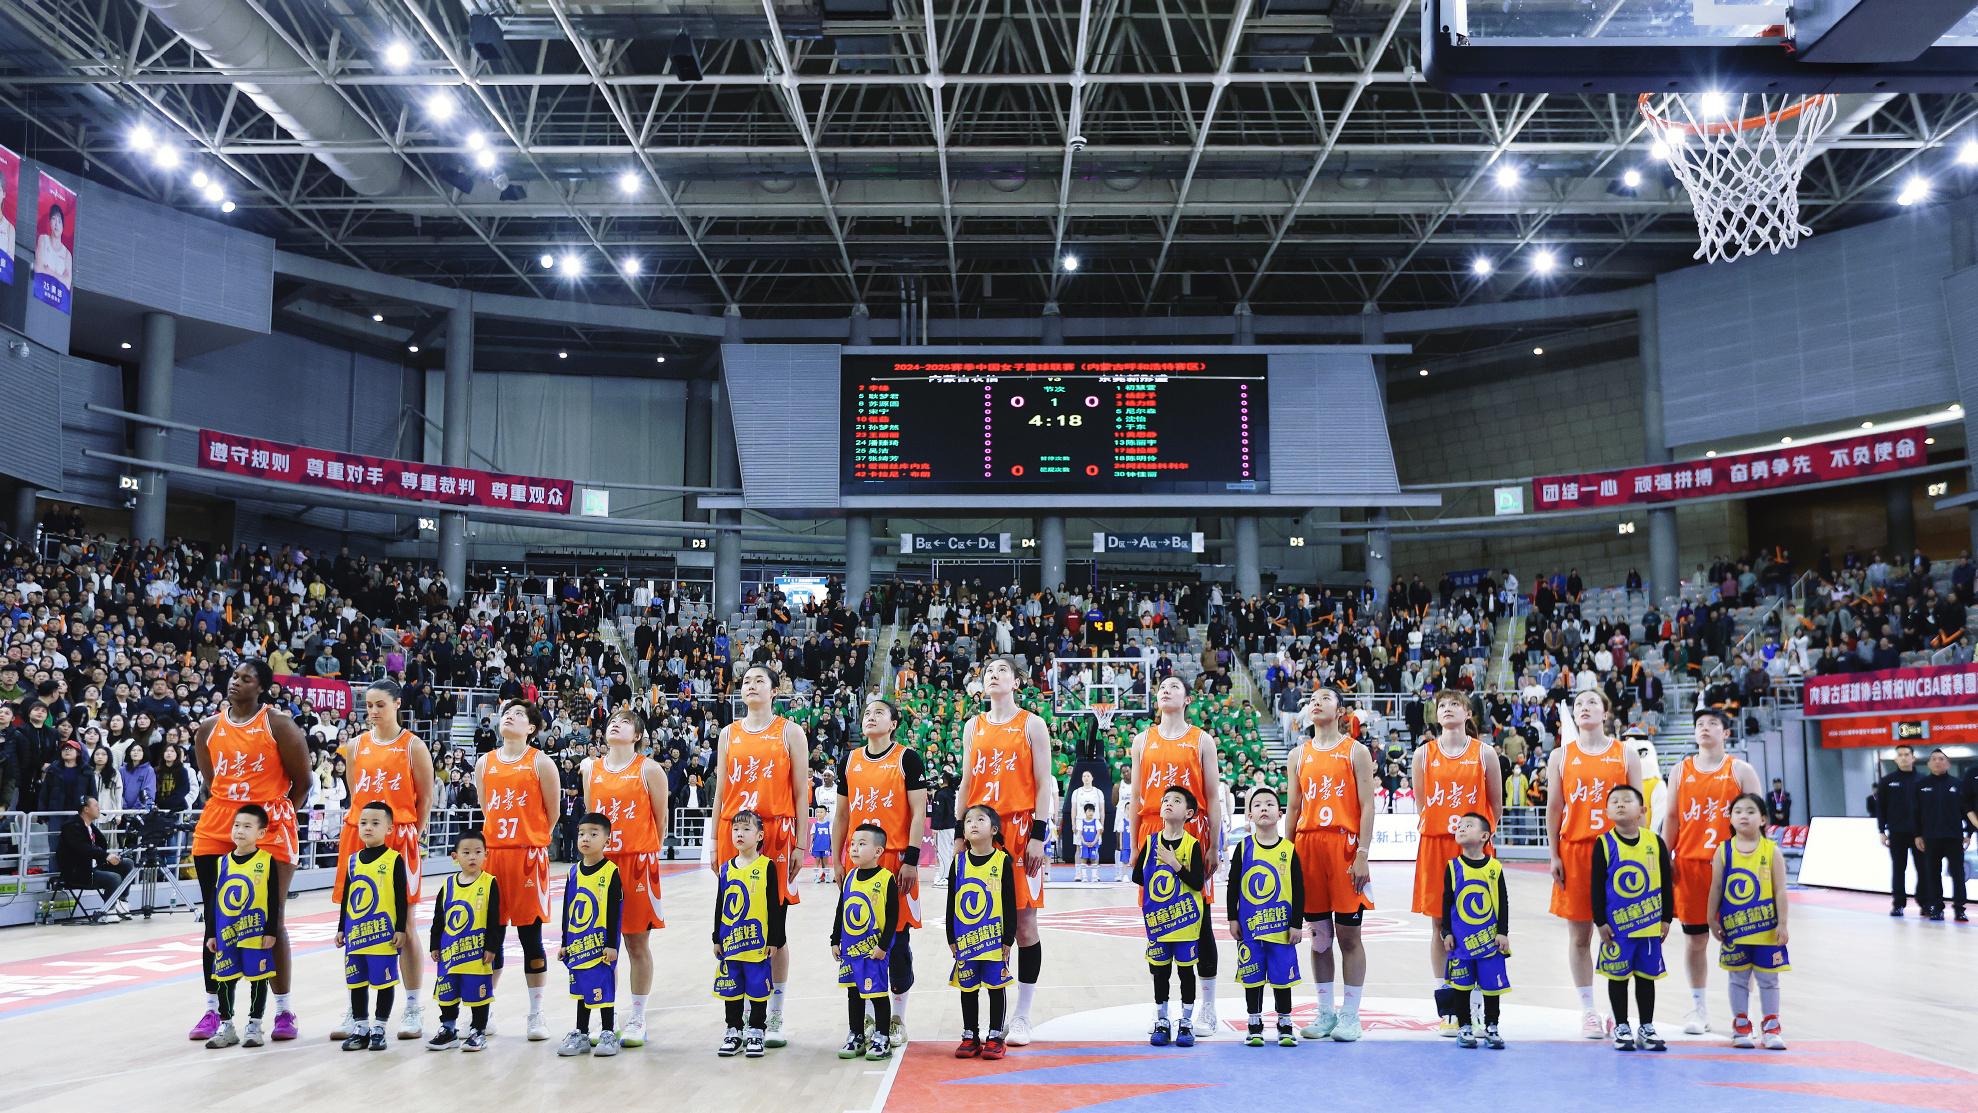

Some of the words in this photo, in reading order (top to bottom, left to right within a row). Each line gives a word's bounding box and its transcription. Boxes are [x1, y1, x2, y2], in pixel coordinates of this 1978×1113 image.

[1010, 396, 1025, 407] 0
[1050, 398, 1058, 407] 1
[1085, 396, 1099, 407] 0
[1028, 415, 1083, 427] 4:18
[209, 440, 290, 473] 遵守规则
[306, 457, 384, 486] 尊重对手
[400, 470, 476, 497] 尊重裁判
[491, 481, 564, 507] 尊重观众
[1011, 465, 1025, 476] 0
[1085, 465, 1099, 476] 0
[1542, 478, 1619, 503] 团结一心
[1634, 467, 1713, 493] 顽强拼搏
[1729, 455, 1813, 484] 奋勇争先
[1829, 438, 1917, 470] 不负使命
[121, 477, 138, 490] D1
[1927, 482, 1948, 497] D7
[419, 519, 436, 530] D2
[1618, 523, 1635, 534] D6
[692, 539, 707, 548] D3
[916, 537, 932, 549] B区
[948, 537, 965, 549] C区
[978, 537, 996, 549] D区
[1021, 539, 1035, 547] D4
[1108, 536, 1126, 548] D区
[1139, 536, 1157, 548] A区
[1172, 536, 1189, 548] B区
[1290, 537, 1304, 546] D5
[1809, 672, 1978, 706] 内蒙古篮球协会预祝WCBA联赛圆
[214, 750, 266, 778] 内蒙古
[729, 755, 775, 785] 内蒙古
[972, 748, 1018, 776] 内蒙古
[355, 768, 402, 793] 内蒙古
[1146, 763, 1191, 789] 内蒙古
[227, 781, 251, 801] 42
[982, 780, 1000, 802] 21
[1304, 774, 1346, 802] 内蒙古
[1426, 781, 1478, 808] 内蒙古
[1569, 777, 1616, 804] 内蒙
[487, 788, 529, 813] 内蒙古
[739, 790, 760, 812] 24
[850, 786, 894, 813] 内蒙古
[1319, 806, 1333, 827] 9
[1447, 814, 1462, 835] 8
[1590, 809, 1605, 830] 5
[497, 817, 520, 840] 37
[1372, 830, 1417, 843] 新上市
[1703, 828, 1718, 849] 2
[1145, 898, 1194, 928] 萌童篮娃
[957, 921, 1002, 951] 萌童篮娃
[592, 987, 603, 1002] 3
